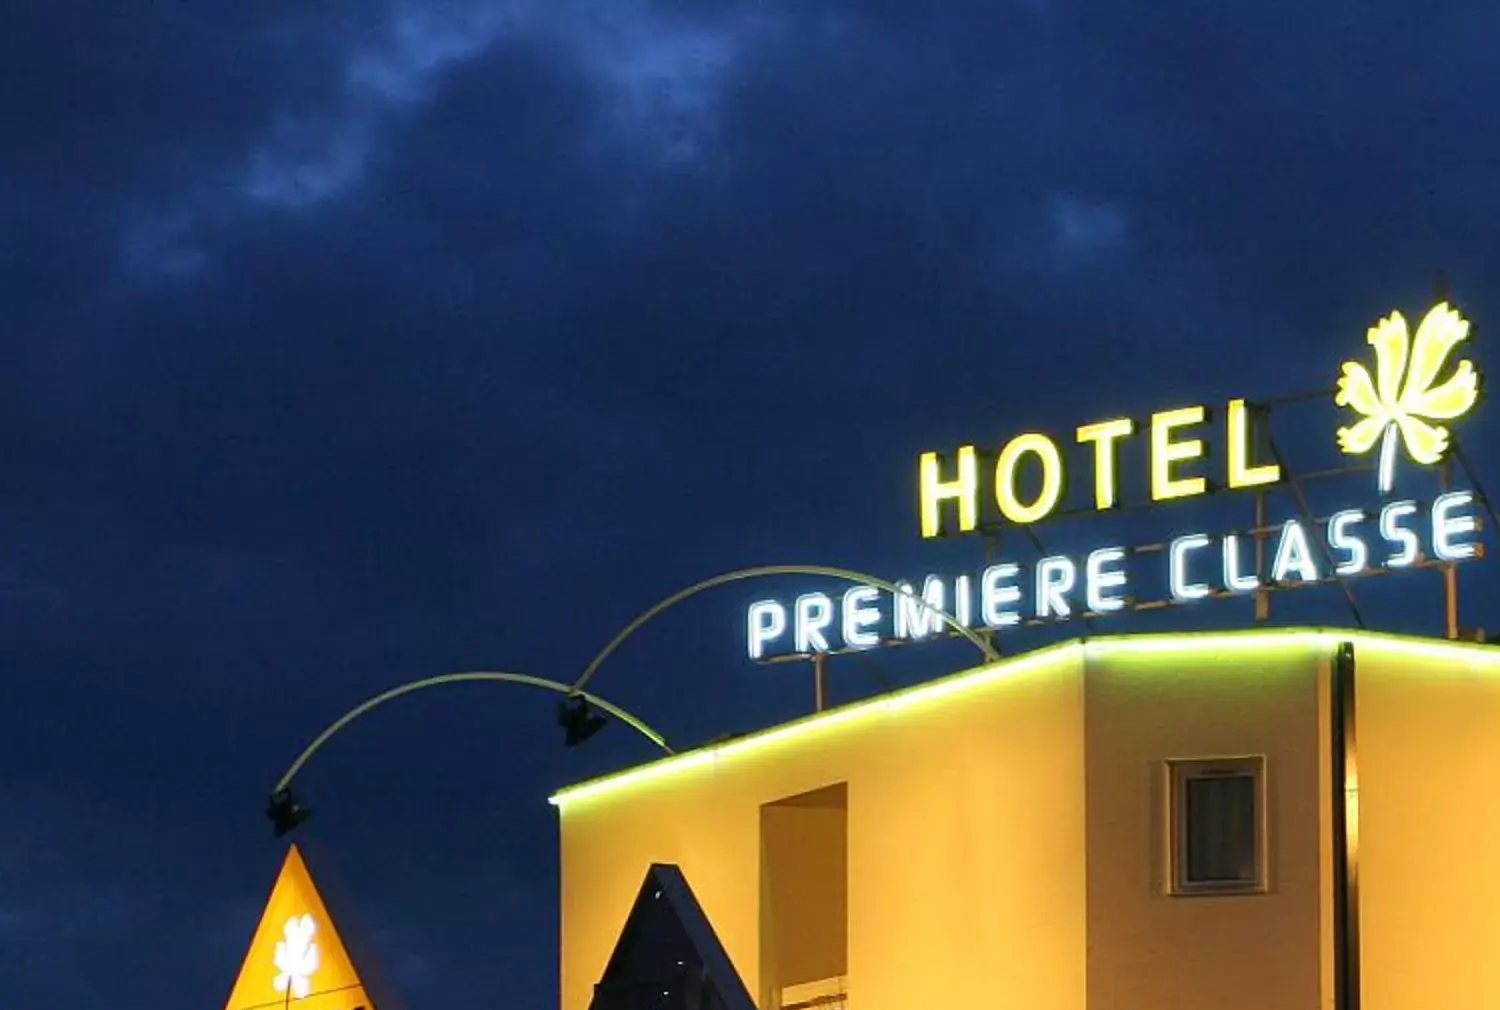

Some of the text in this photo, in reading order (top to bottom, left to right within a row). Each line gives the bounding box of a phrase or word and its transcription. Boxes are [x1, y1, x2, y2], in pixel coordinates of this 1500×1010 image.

[919, 398, 1281, 539] HOTEL
[746, 489, 1479, 660] PREMIERE CLASSE
